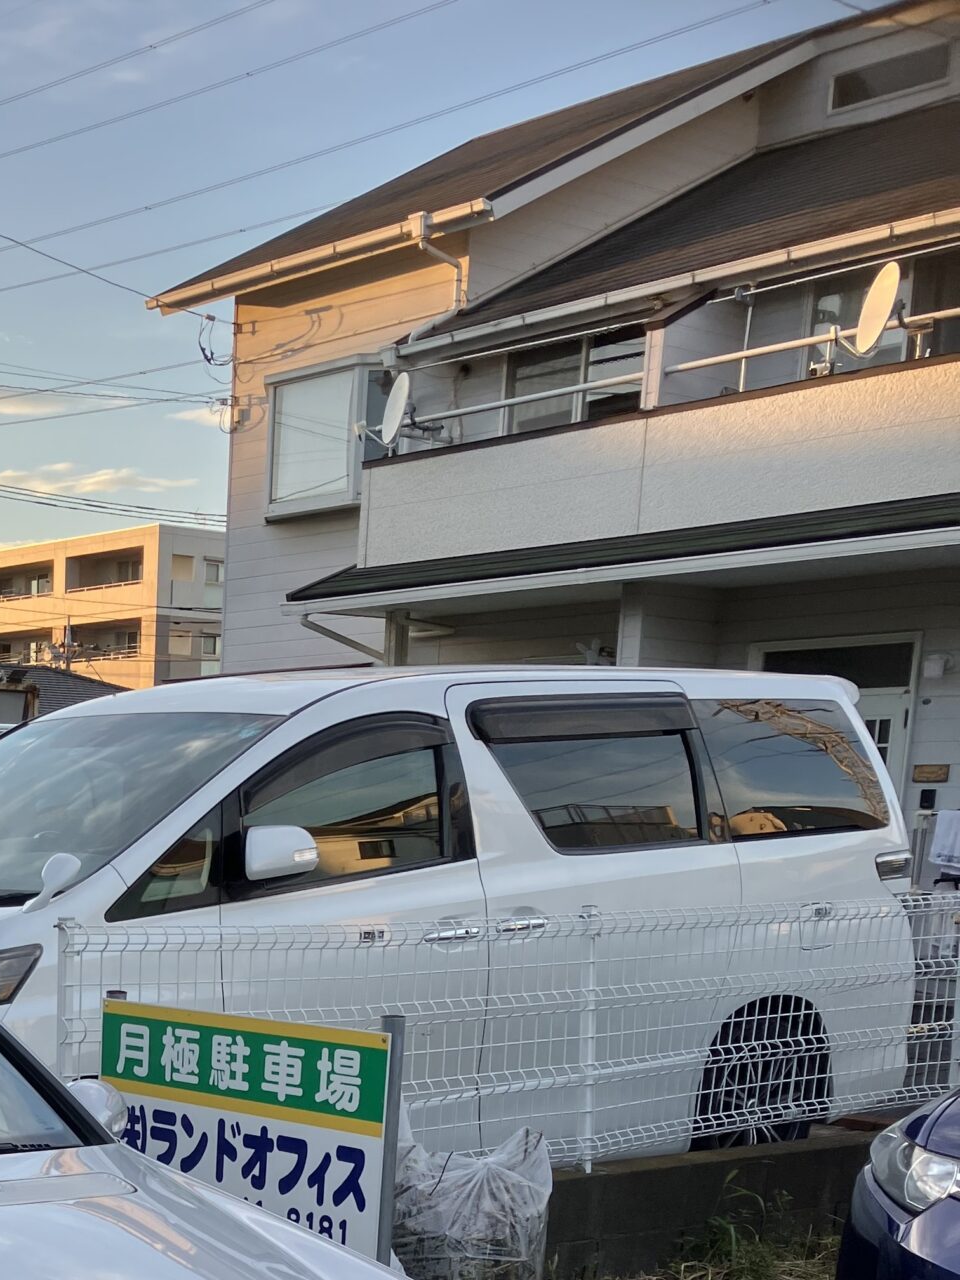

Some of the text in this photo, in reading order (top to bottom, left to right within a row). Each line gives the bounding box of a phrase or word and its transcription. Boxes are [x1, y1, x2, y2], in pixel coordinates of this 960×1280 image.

[116, 1023, 362, 1112] 月極駐車場
